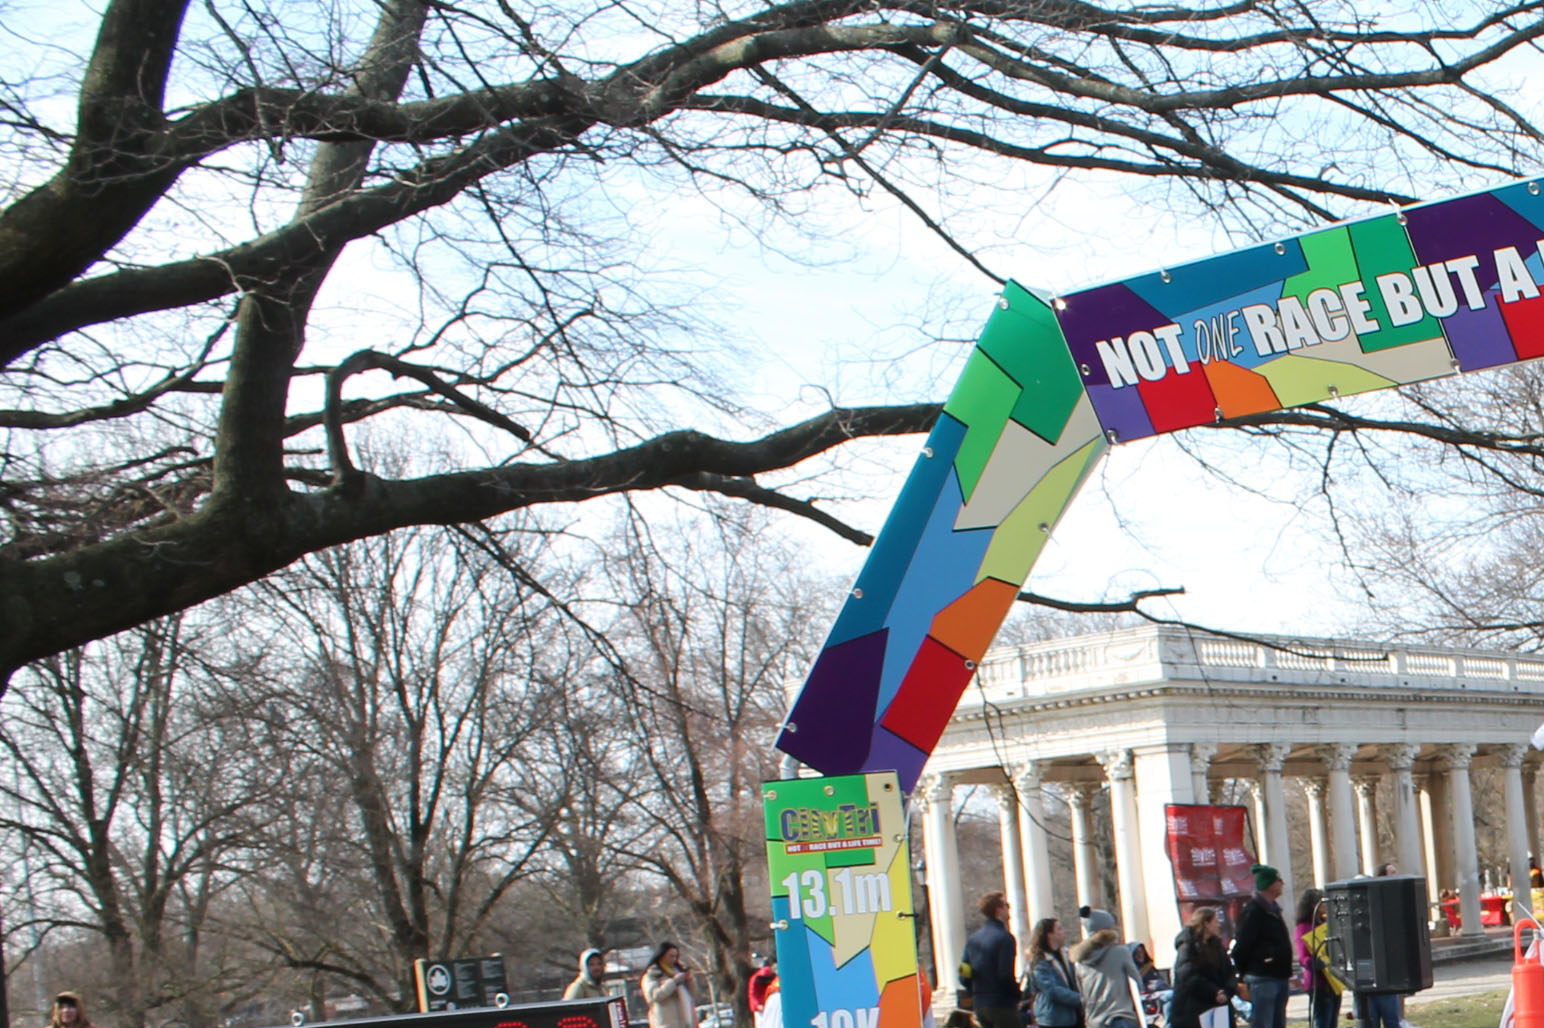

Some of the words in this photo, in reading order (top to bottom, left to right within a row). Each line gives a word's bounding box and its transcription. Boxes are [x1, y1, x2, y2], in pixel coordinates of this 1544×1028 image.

[1096, 322, 1185, 390] NOT
[1193, 313, 1243, 367] ONE
[1245, 288, 1381, 359] RACE
[1376, 255, 1489, 327] BUT
[1491, 247, 1541, 302] A
[782, 868, 892, 920] 13.1m
